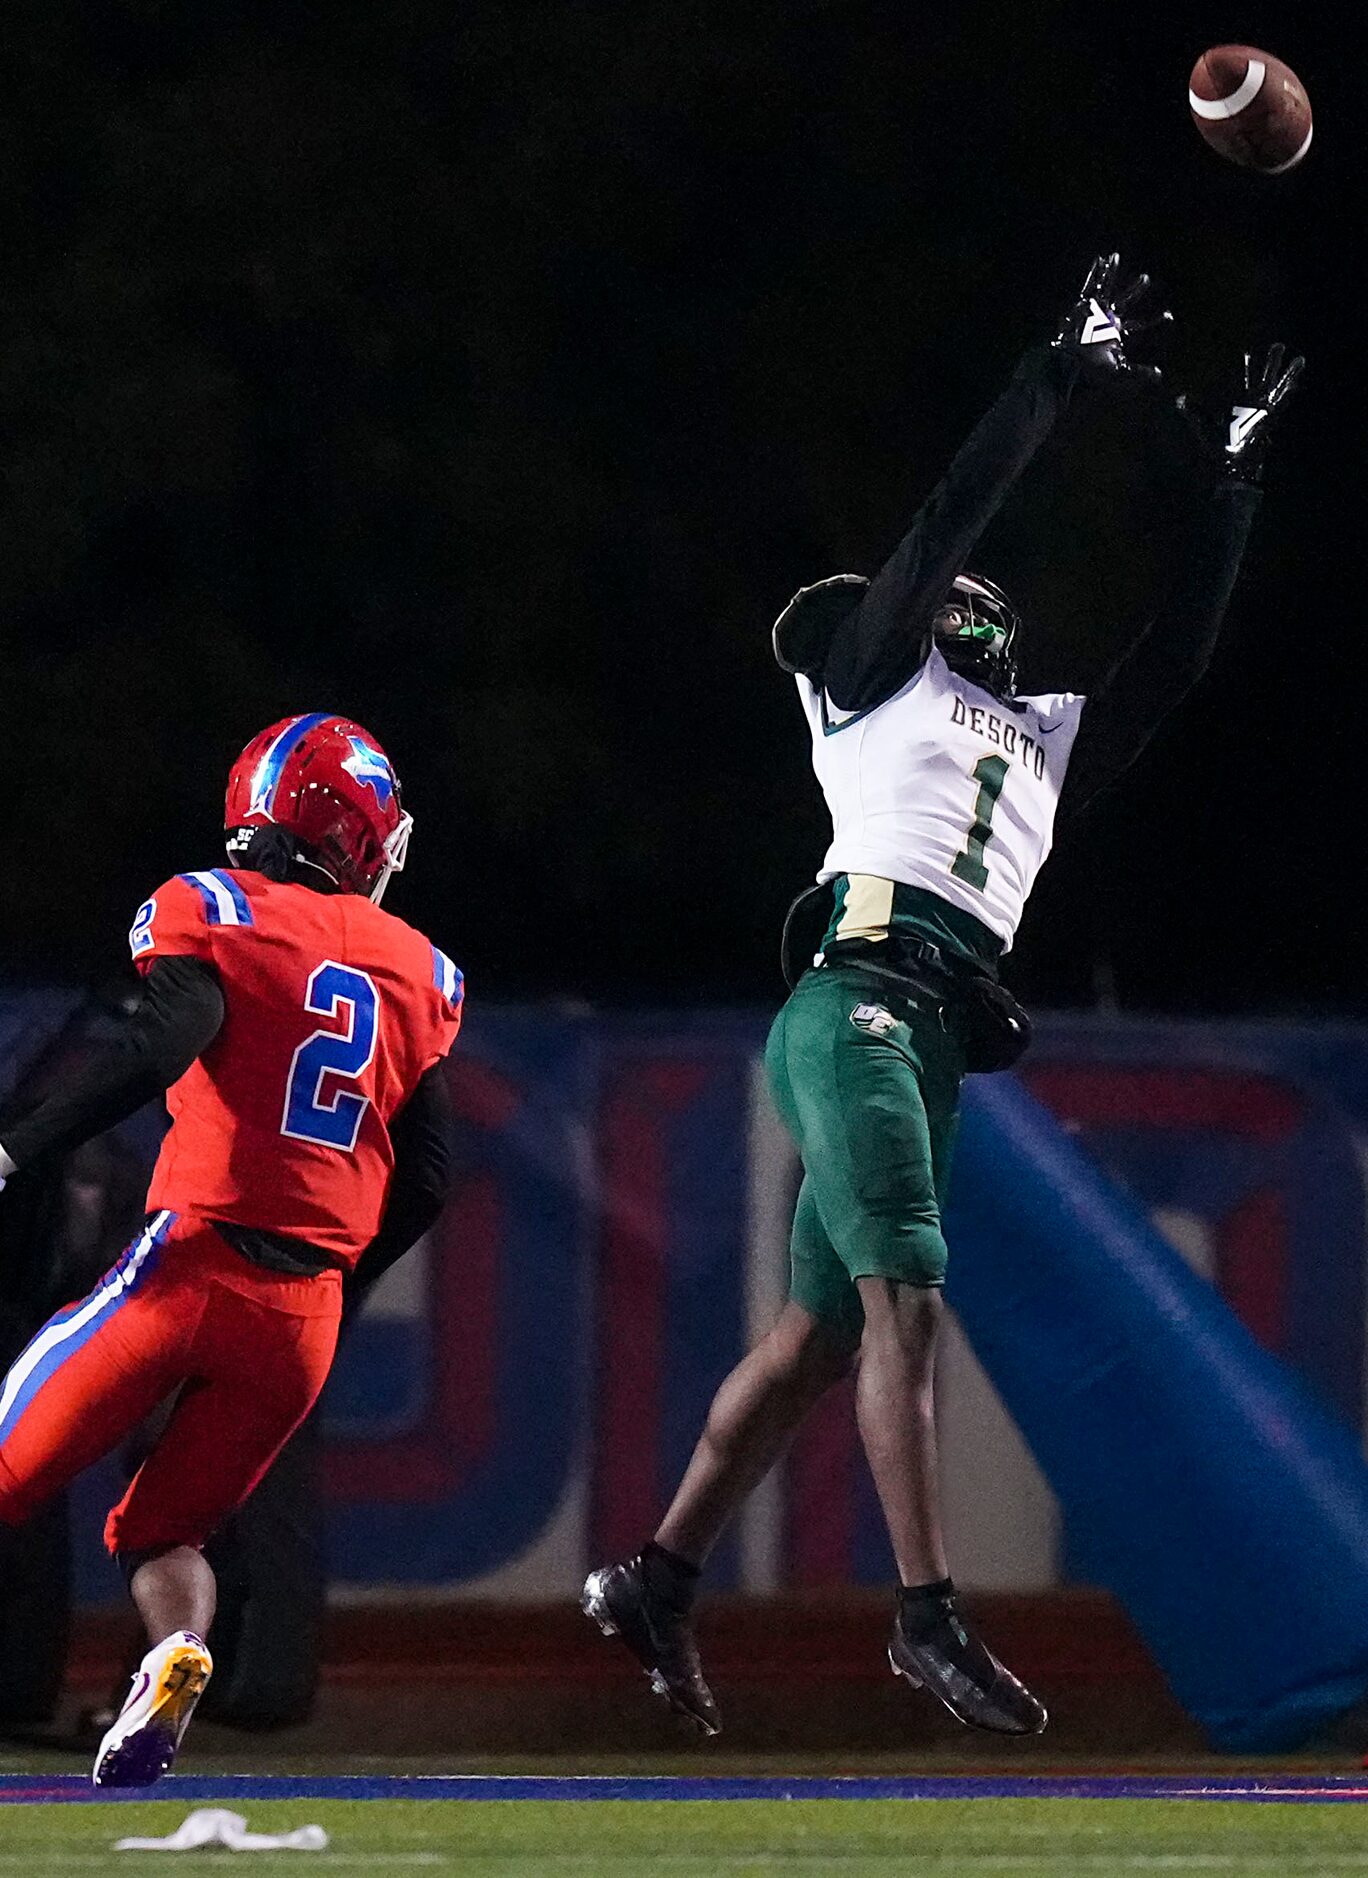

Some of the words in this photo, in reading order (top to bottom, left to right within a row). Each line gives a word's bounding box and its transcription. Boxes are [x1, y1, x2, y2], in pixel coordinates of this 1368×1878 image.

[950, 695, 1045, 781] DESOTO
[949, 752, 1010, 893] 1
[129, 898, 157, 960] 2
[280, 959, 381, 1153] 2
